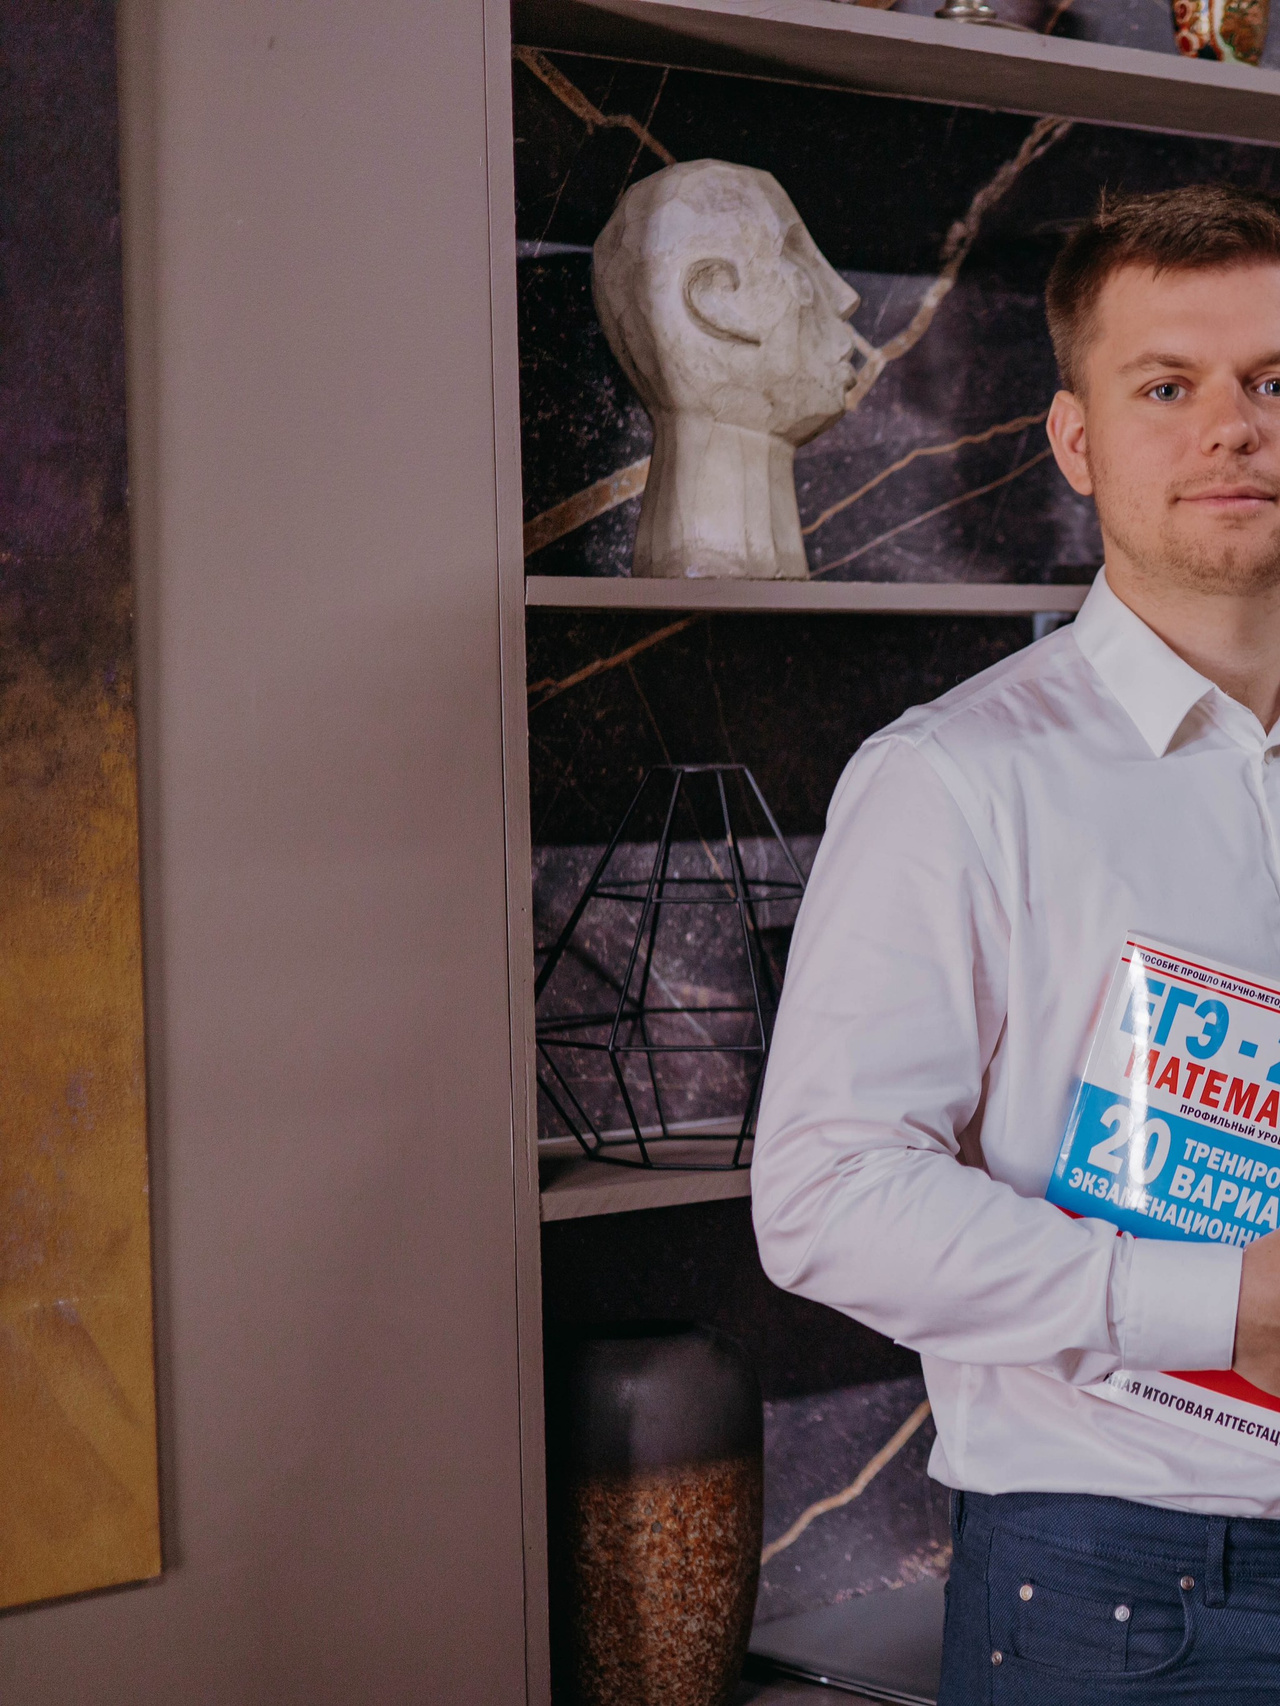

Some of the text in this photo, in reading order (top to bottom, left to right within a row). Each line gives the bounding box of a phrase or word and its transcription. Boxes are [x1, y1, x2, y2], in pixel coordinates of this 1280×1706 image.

[1139, 952, 1180, 973] ПОСОБИЕ
[1180, 966, 1219, 986] ПРОШЛО
[1119, 976, 1230, 1060] ЕГЭ
[1087, 1103, 1171, 1185] 20
[1179, 1104, 1257, 1137] ПРОФИЛЬНЫЙ
[1068, 1167, 1261, 1248] ЭКЗАМЕНАЦИОНН
[1142, 1385, 1214, 1422] ИТОГОВАЯ
